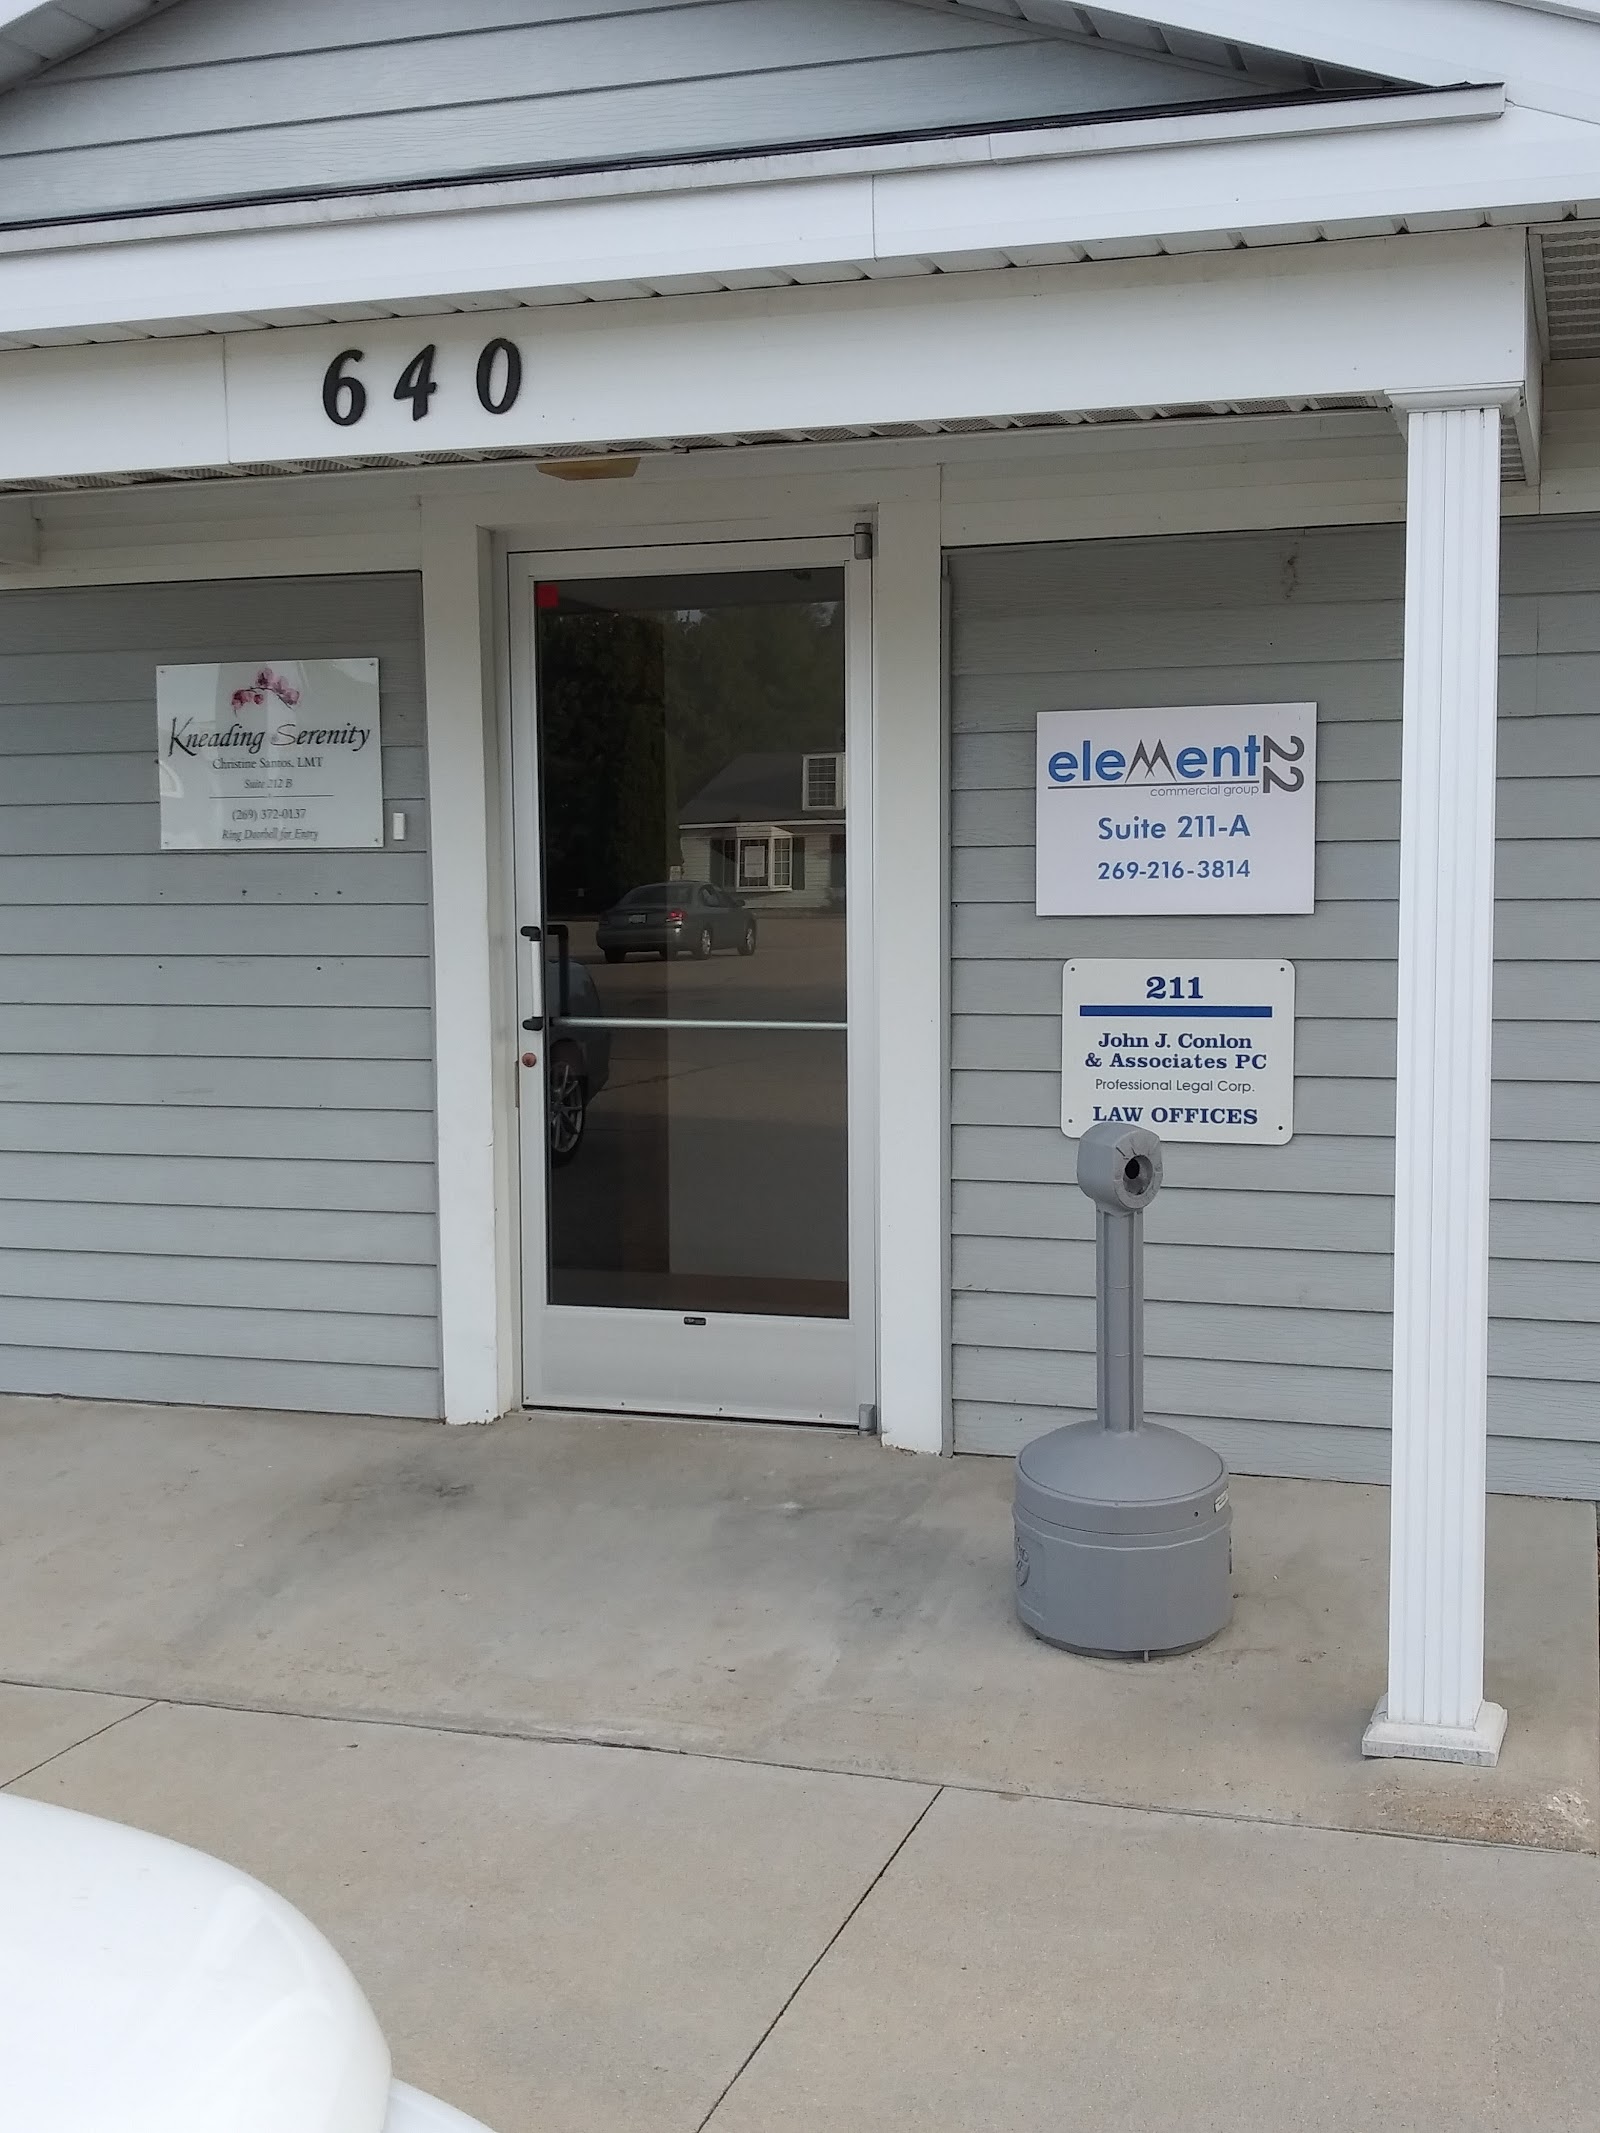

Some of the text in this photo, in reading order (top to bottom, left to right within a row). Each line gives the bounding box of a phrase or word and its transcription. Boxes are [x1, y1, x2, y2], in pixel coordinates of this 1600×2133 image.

[323, 338, 522, 426] 640
[168, 717, 371, 756] Kneading Serenity
[213, 758, 257, 770] Christine
[297, 757, 323, 768] LMT
[244, 779, 293, 789] Suite 212 B
[1150, 785, 1260, 797] commercial group
[232, 808, 307, 821] (269) 372-0137
[222, 829, 242, 843] Ring
[278, 827, 292, 842] for
[294, 829, 319, 842] Entry
[1098, 814, 1251, 840] Suite 211-A
[1098, 859, 1251, 880] 269-216-3814
[1146, 976, 1204, 1000] 211
[1098, 1032, 1252, 1049] John J. Conlon
[1084, 1052, 1267, 1070] & Associates PC
[1095, 1079, 1255, 1094] Professional Legal Corp.
[1092, 1106, 1259, 1125] LAW OFFICES
